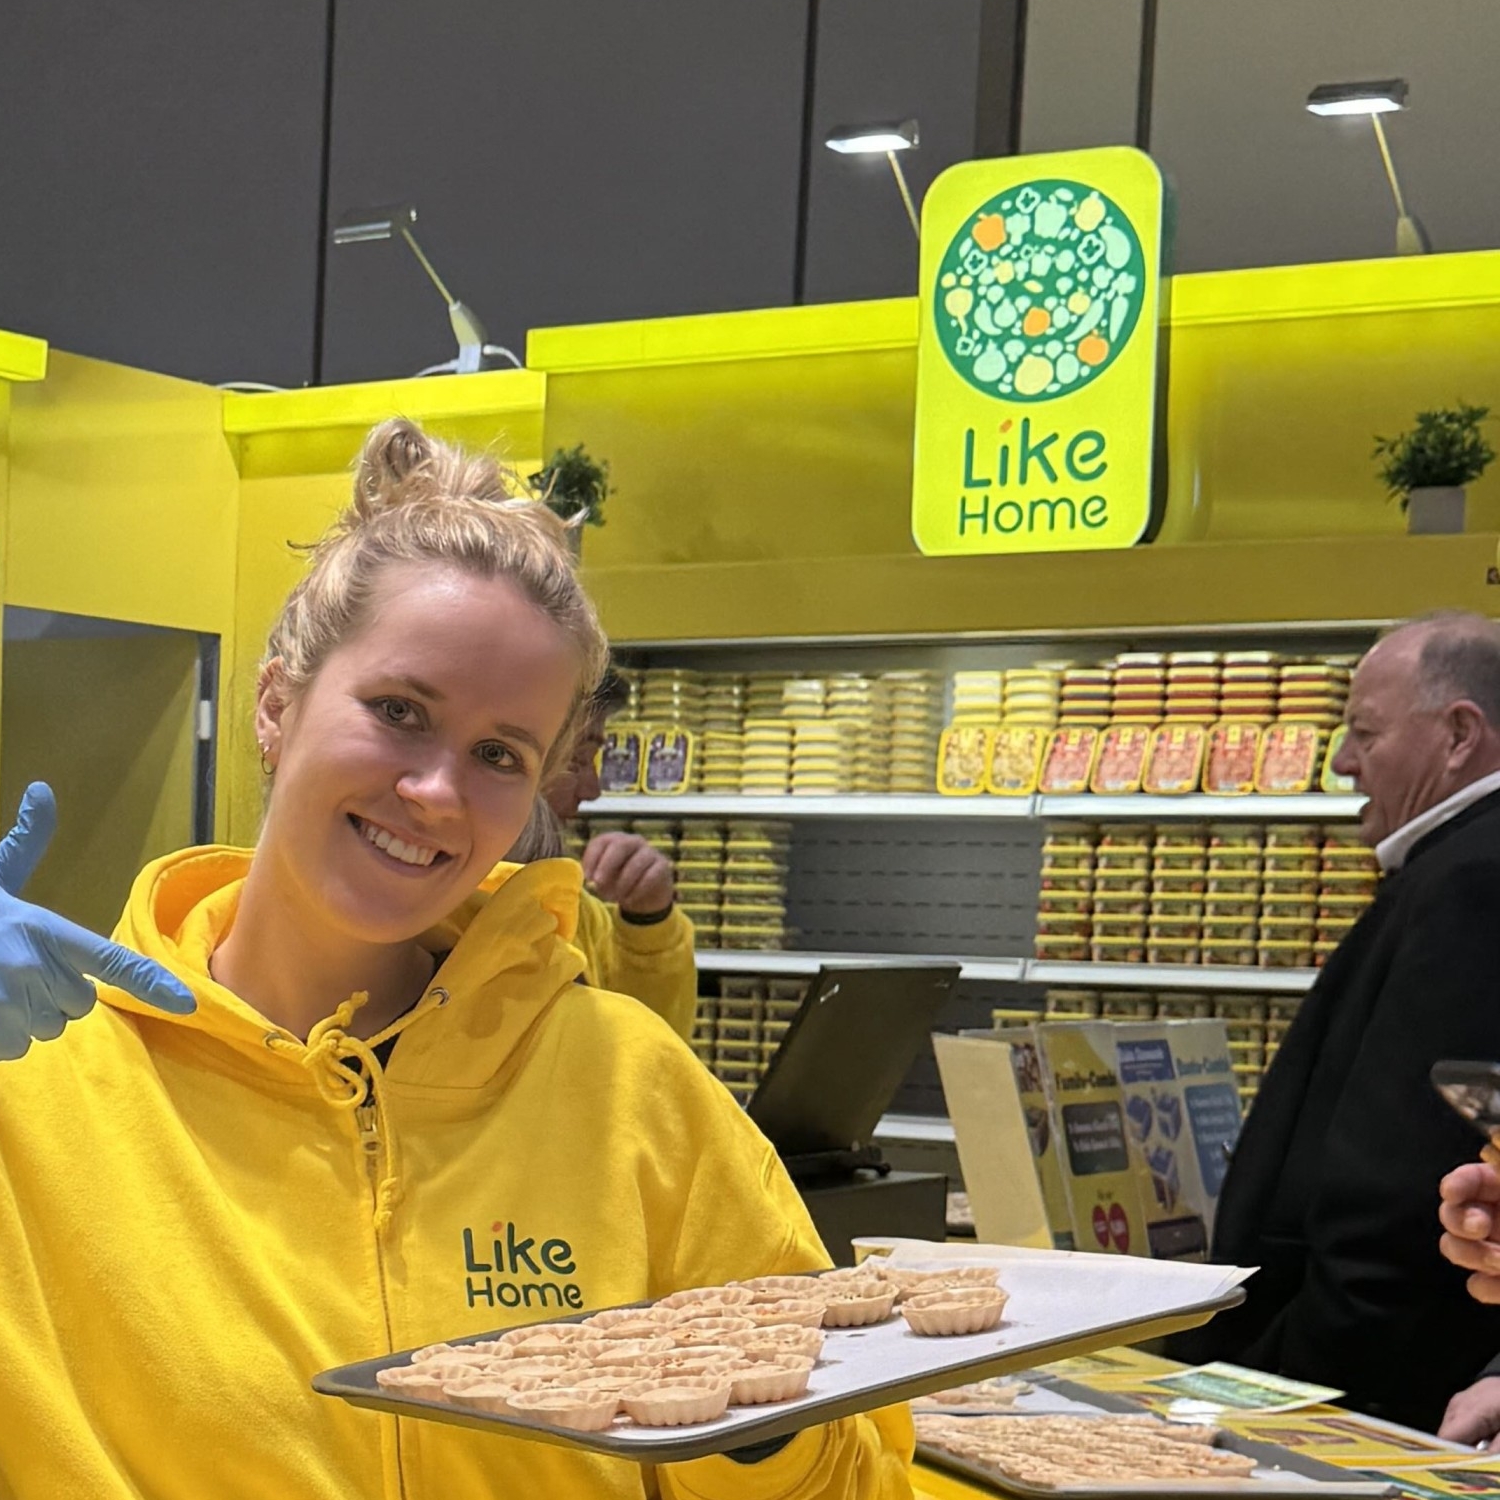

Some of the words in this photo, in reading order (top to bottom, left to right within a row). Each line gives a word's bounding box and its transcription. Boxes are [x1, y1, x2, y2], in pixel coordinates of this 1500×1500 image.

[964, 417, 1107, 488] Like
[959, 495, 1108, 536] Home
[463, 1221, 576, 1275] Like
[466, 1276, 583, 1309] Home
